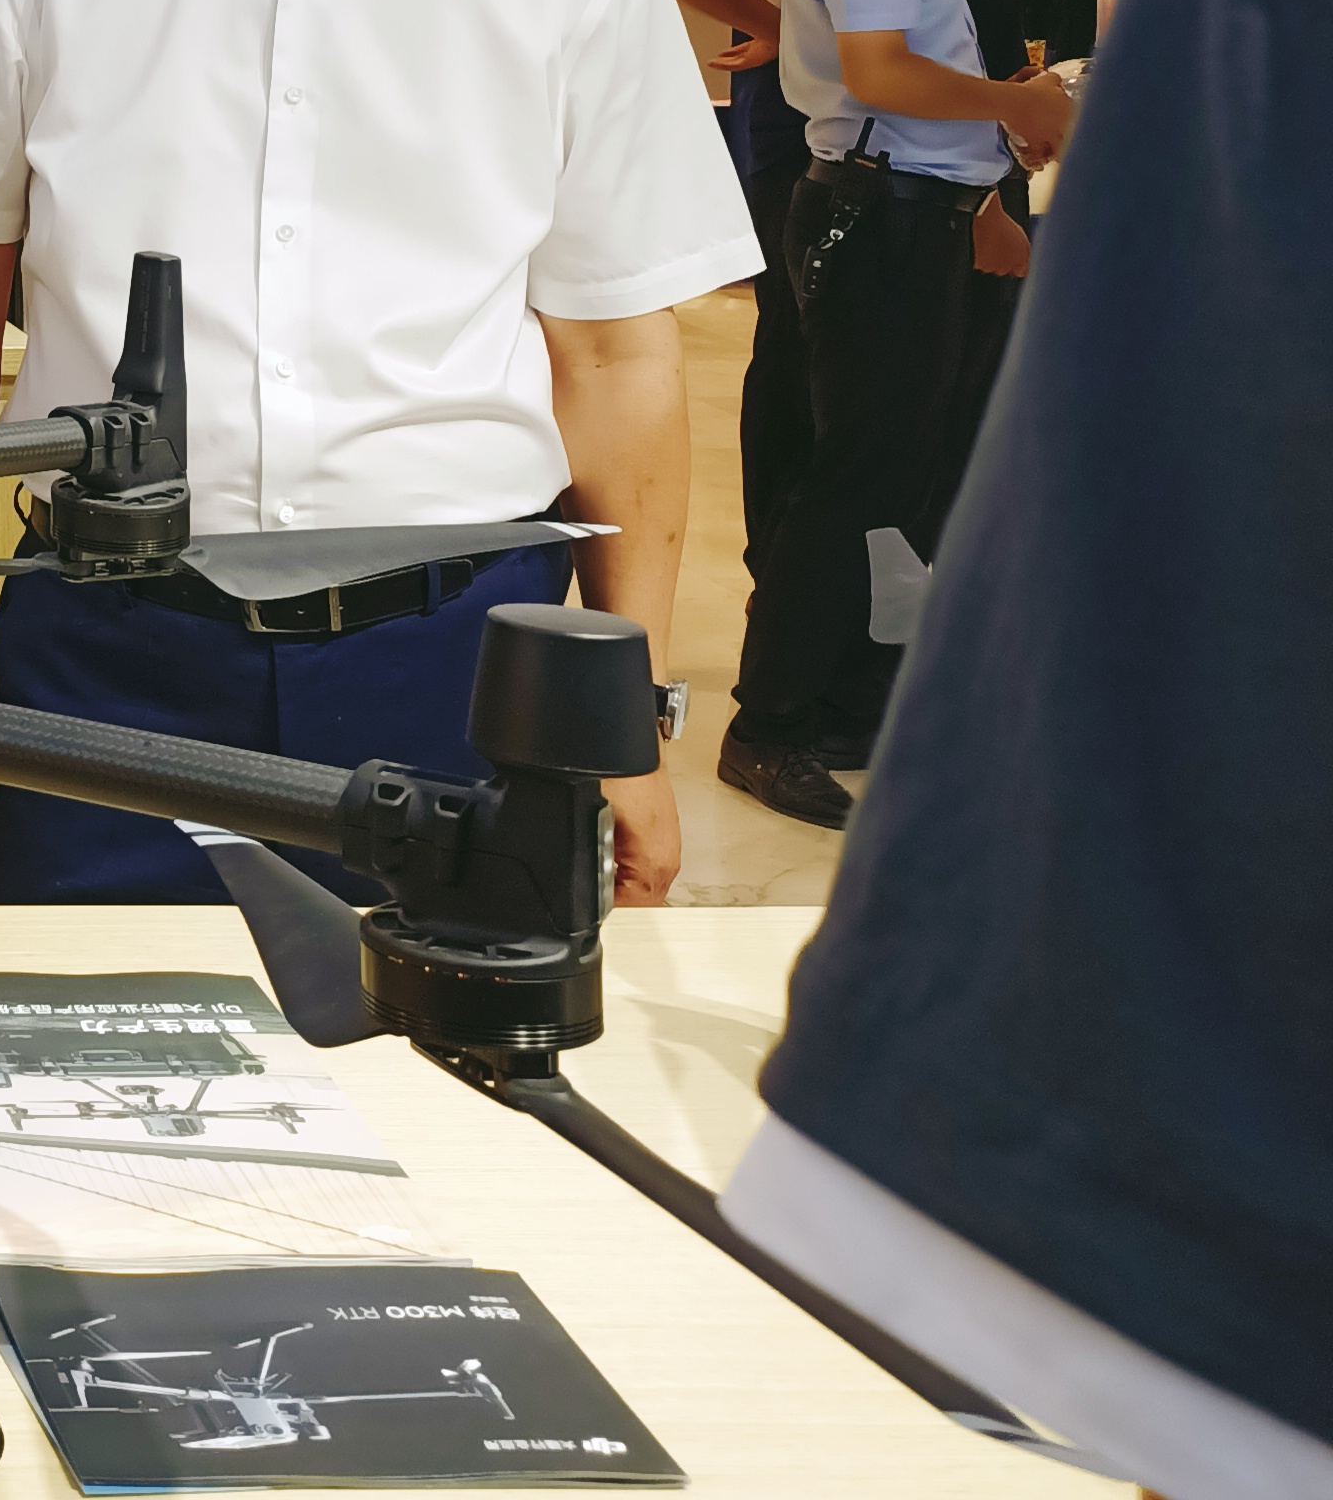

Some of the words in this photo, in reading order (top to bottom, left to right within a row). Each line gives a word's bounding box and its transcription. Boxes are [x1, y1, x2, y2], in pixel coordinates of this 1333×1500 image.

[210, 1003, 243, 1014] DJI
[79, 1019, 258, 1035] 重塑生产力
[326, 1305, 381, 1321] RTK
[385, 1305, 465, 1320] M300
